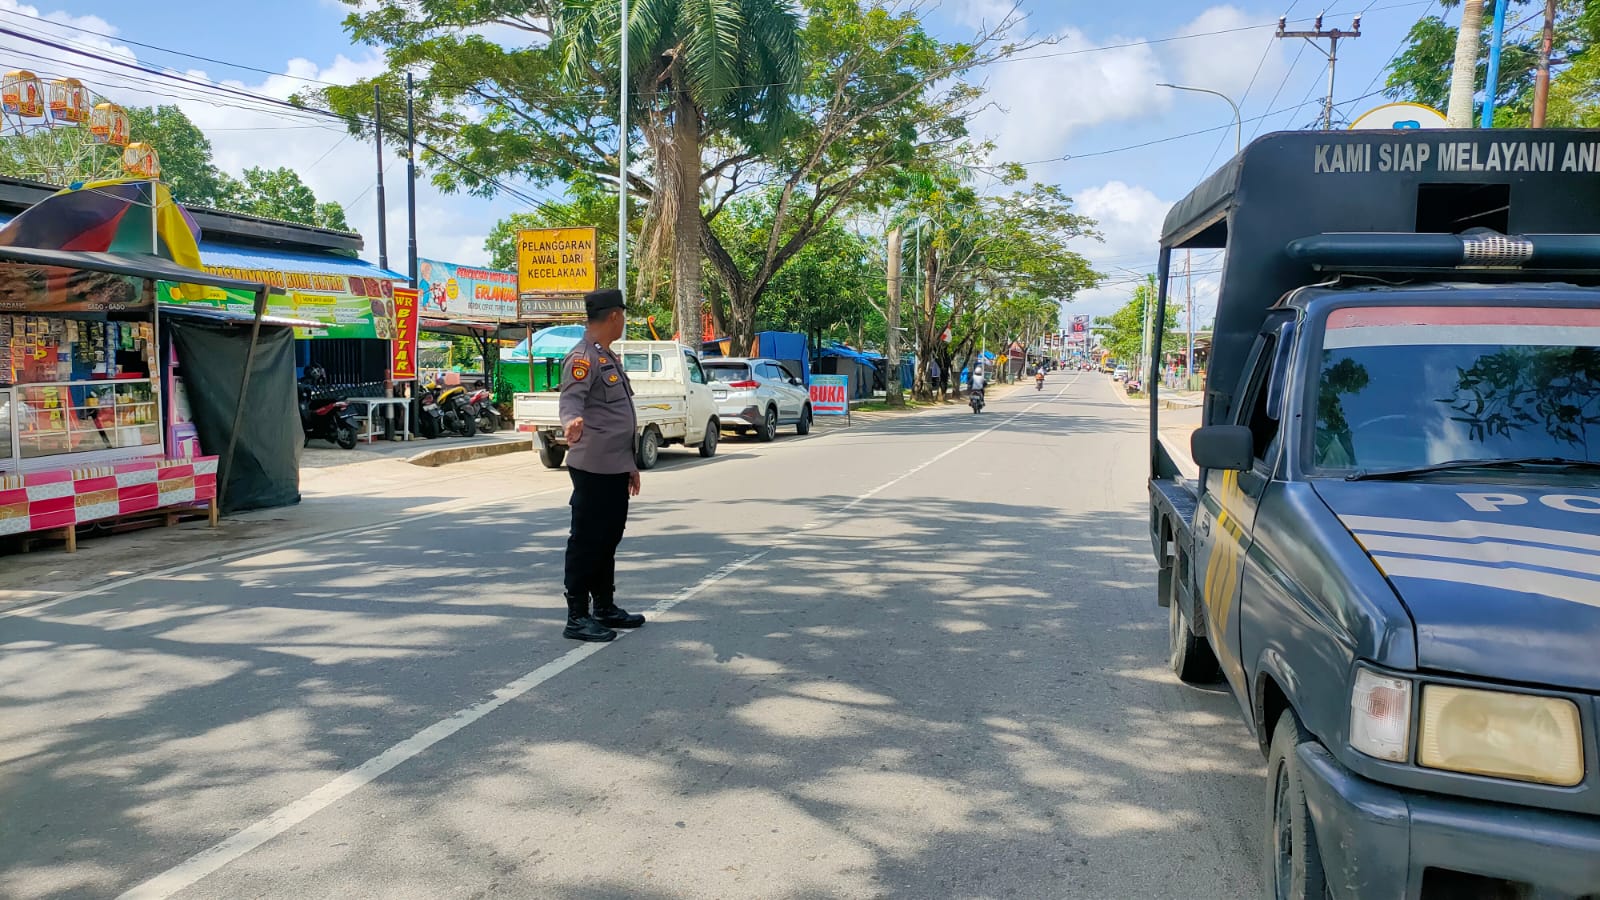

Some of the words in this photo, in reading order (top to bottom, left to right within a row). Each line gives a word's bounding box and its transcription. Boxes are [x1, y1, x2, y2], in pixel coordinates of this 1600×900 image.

[1314, 144, 1370, 173] KAMI
[1378, 143, 1430, 172] SIAP
[1437, 142, 1555, 172] MELAYANI
[522, 240, 591, 252] PELANGGARAN
[532, 255, 557, 265] AWAL
[562, 254, 583, 264] DARI
[528, 268, 587, 279] KECELAKAAN
[395, 297, 413, 306] WR
[534, 301, 552, 310] JASA
[1074, 323, 1083, 331] 16
[395, 309, 410, 370] BLITAR
[810, 385, 845, 403] BUKA
